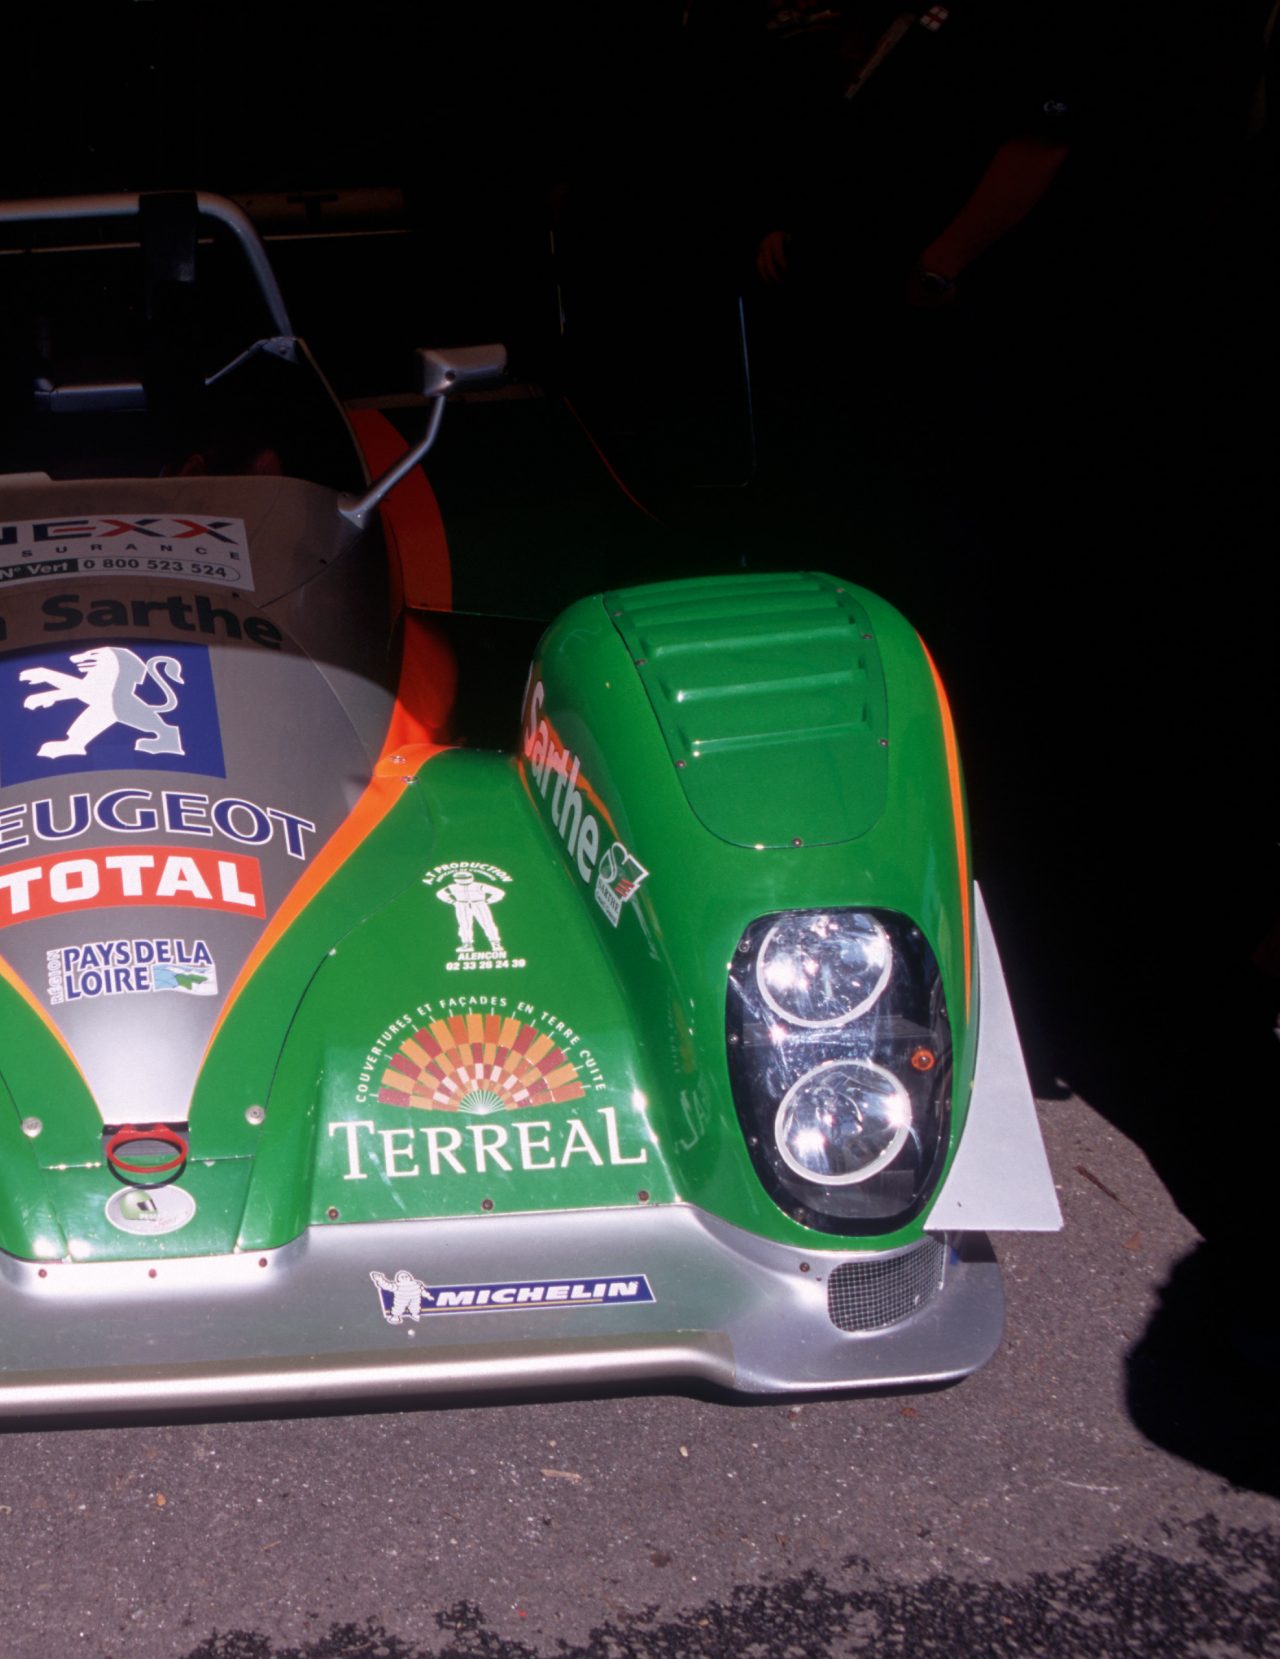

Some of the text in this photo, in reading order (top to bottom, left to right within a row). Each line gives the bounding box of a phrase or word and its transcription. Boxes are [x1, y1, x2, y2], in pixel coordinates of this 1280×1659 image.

[27, 561, 69, 575] Vert
[84, 559, 95, 570] 0
[103, 558, 139, 569] 800
[147, 560, 183, 571] 523
[191, 563, 226, 578] 524
[41, 594, 282, 650] Sarthe
[524, 681, 599, 883] Sarthe
[434, 861, 514, 882] PRODUCTION
[63, 939, 214, 973] PAYS DE LA
[64, 966, 151, 1001] LOIRE
[355, 1014, 412, 1103] COUVERTURES
[416, 1003, 433, 1016] ET
[517, 1002, 534, 1014] EN
[541, 1011, 580, 1045] TERRE
[579, 1049, 606, 1091] CUITE
[328, 1106, 648, 1180] TERREAL
[435, 1281, 639, 1307] MICHELIN
